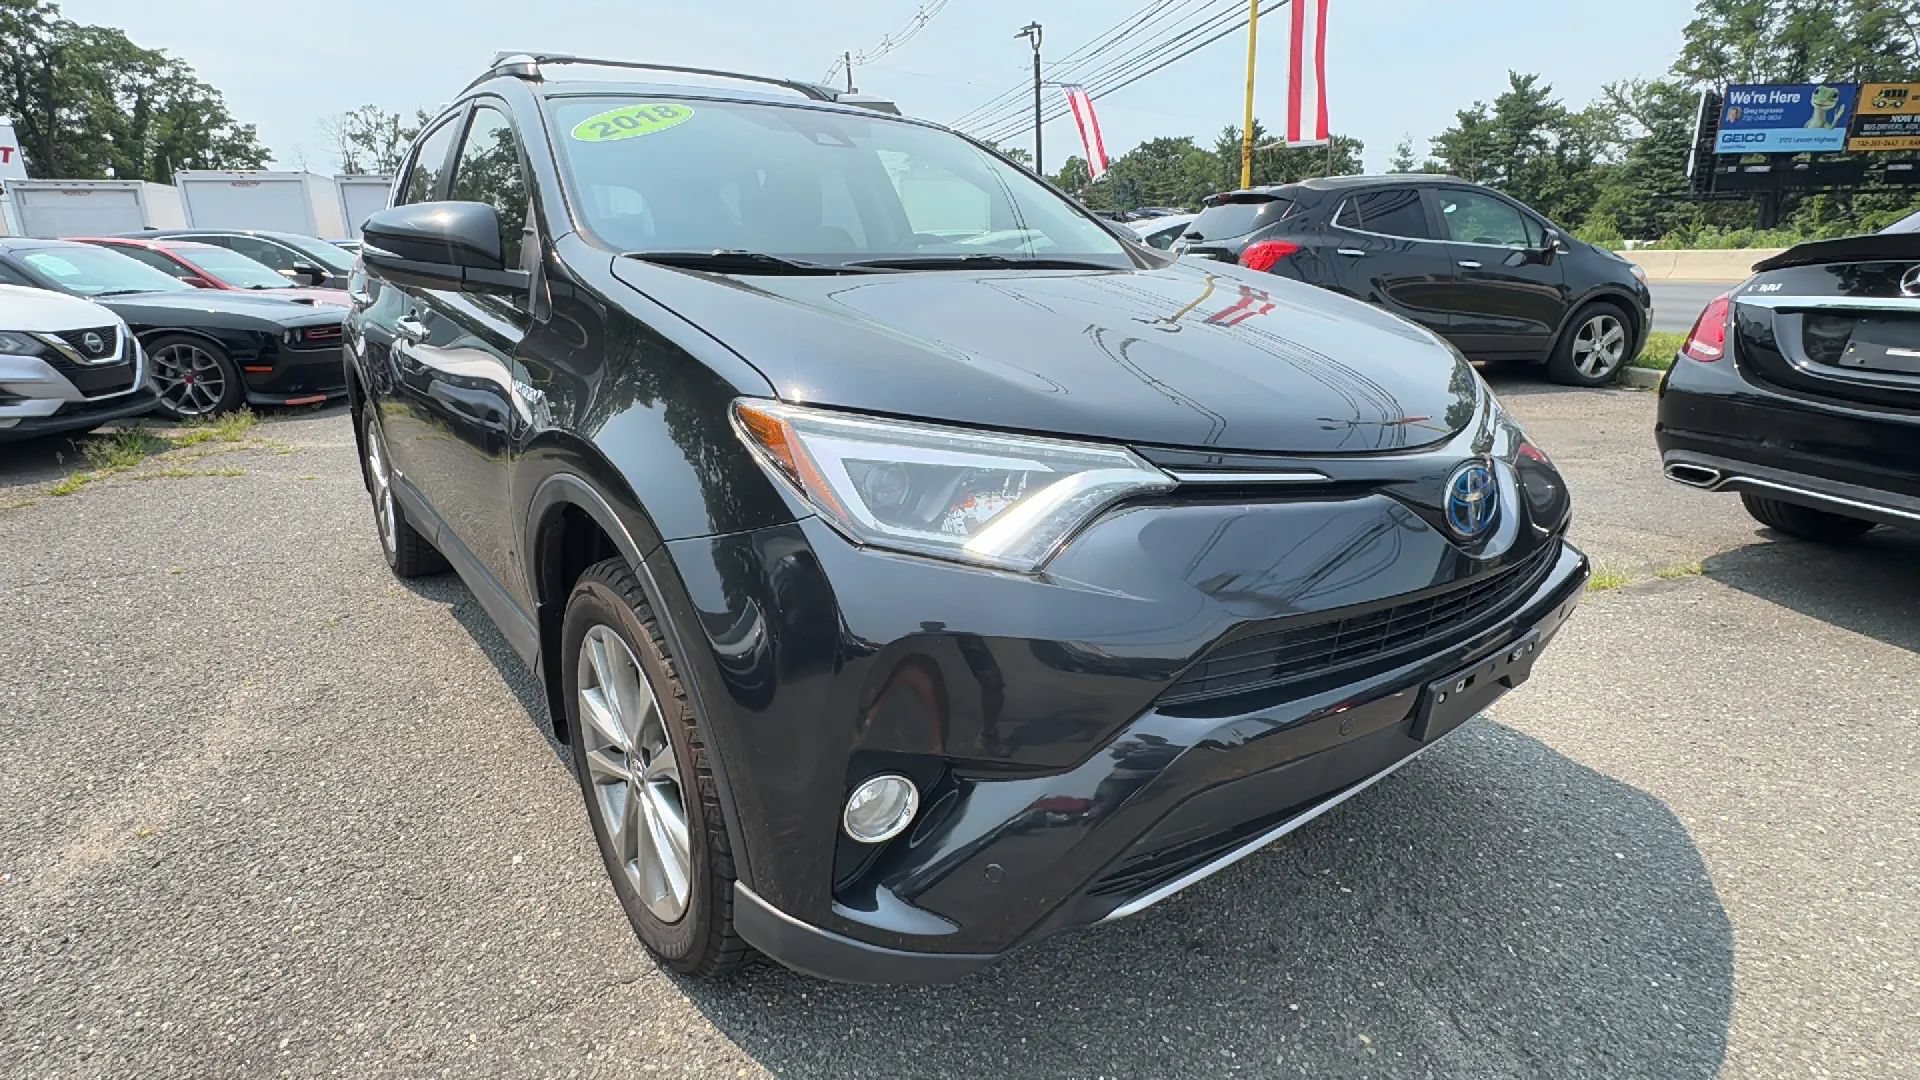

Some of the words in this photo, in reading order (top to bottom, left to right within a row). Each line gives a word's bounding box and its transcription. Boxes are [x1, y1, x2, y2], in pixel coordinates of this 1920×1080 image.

[1730, 91, 1766, 104] We're
[1769, 90, 1801, 104] Here
[589, 105, 680, 138] 2018
[1722, 133, 1766, 143] GEICO
